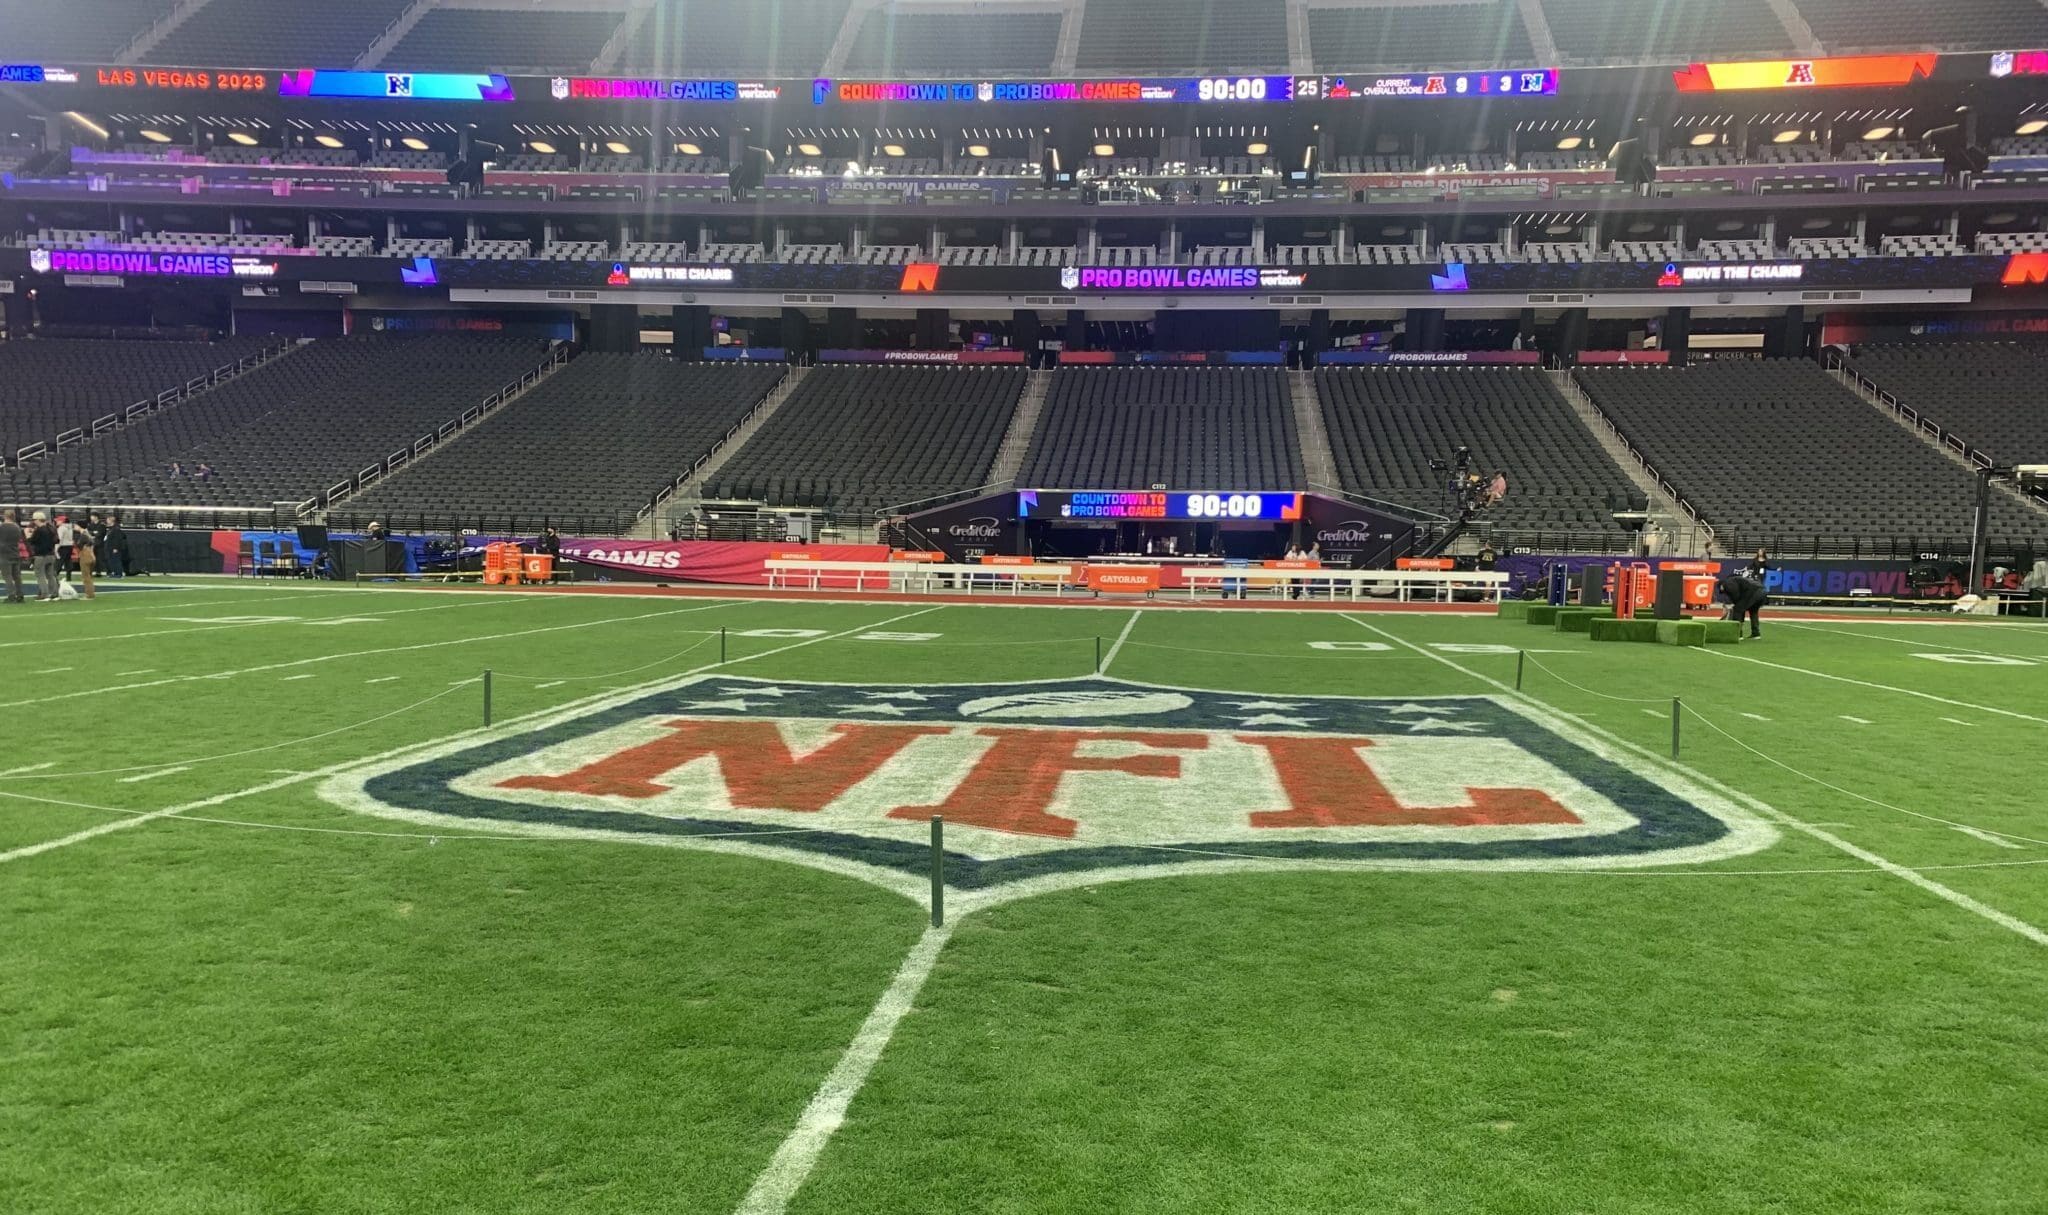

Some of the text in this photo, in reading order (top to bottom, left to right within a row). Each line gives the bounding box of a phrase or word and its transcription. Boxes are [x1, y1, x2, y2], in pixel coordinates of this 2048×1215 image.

[99, 71, 265, 90] LAS VEGAS 2023
[1298, 80, 1318, 95] 25
[1376, 79, 1411, 87] CURRENT
[1456, 77, 1468, 93] 9
[1500, 77, 1512, 92] 3
[571, 80, 736, 99] PRO BOWL GAMES
[738, 88, 776, 99] verizon
[839, 82, 1141, 100] COUNTDOWN TO PRO BOWL GAMES
[1199, 78, 1266, 100] 90:00
[1363, 87, 1396, 95] OVERALL
[53, 252, 230, 274] PRO BOWL GAMES
[232, 264, 274, 275] verizon
[629, 266, 663, 280] MOVE
[664, 267, 688, 280] THE
[689, 268, 733, 281] CHAINS
[1082, 268, 1257, 287] PRO BOWL GAMES
[1683, 264, 1802, 280] MOVE THE CHAINS
[1260, 275, 1301, 286] verizon
[884, 352, 959, 361] #PROBOWLGAMES
[1388, 353, 1468, 361] #PROBOWLGAMES
[1072, 493, 1166, 504] COUNTDOWN TO
[1187, 494, 1261, 517] 90:00
[1071, 506, 1166, 516] PRO BOWL GAMES
[461, 528, 478, 536] C110
[1513, 547, 1531, 555] C113
[1920, 552, 1939, 561] C114
[529, 560, 541, 573] G
[1100, 575, 1148, 584] GATORADE
[1765, 570, 1821, 593] PRO
[1826, 571, 1912, 595] BOWL
[1695, 583, 1708, 598] G
[495, 718, 1584, 840] NFL
